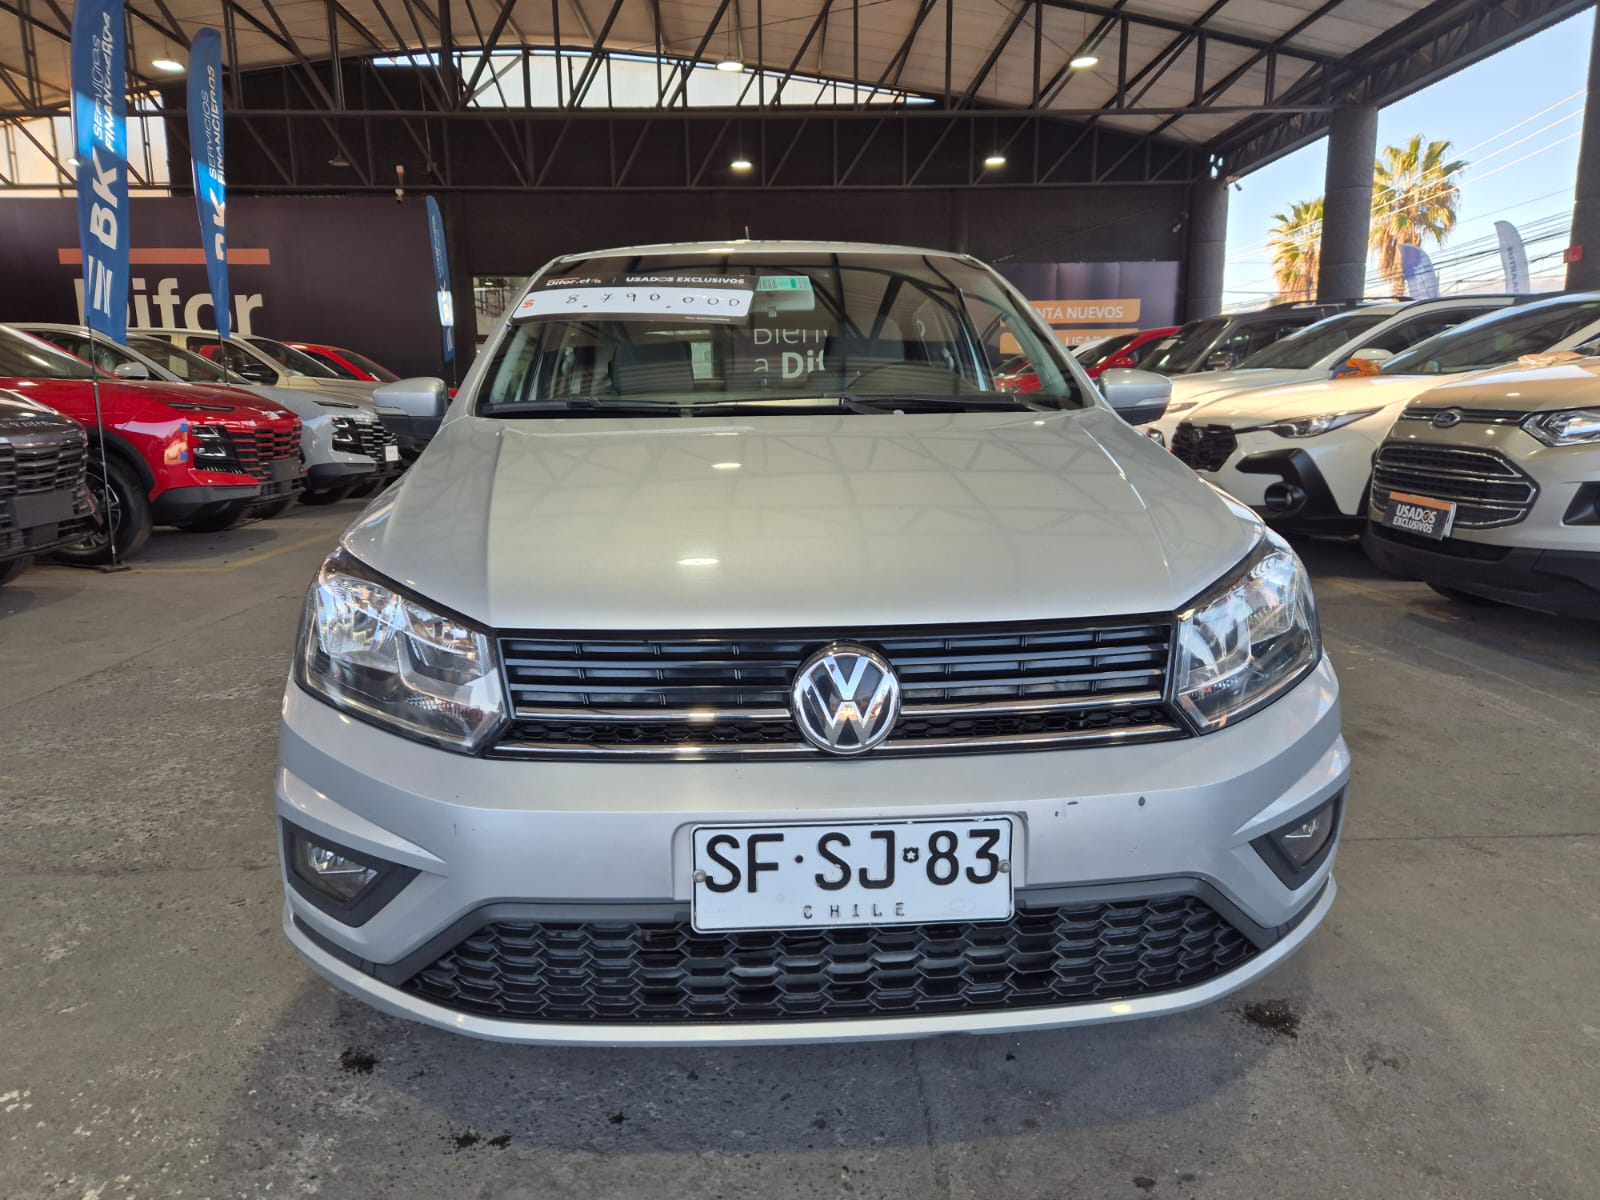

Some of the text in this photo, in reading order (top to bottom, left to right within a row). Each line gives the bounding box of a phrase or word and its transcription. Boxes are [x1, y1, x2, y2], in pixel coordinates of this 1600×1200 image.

[201, 89, 218, 180] SERVICIOS
[89, 145, 118, 250] BK
[676, 276, 745, 284] EXCLUSIVOS
[73, 277, 264, 336] ifor
[1066, 306, 1124, 319] NUEVOS
[754, 328, 828, 345] Bien
[1396, 504, 1438, 524] USADOS
[1392, 516, 1434, 534] EXCLUSIVOS
[803, 902, 905, 919] CHILE
